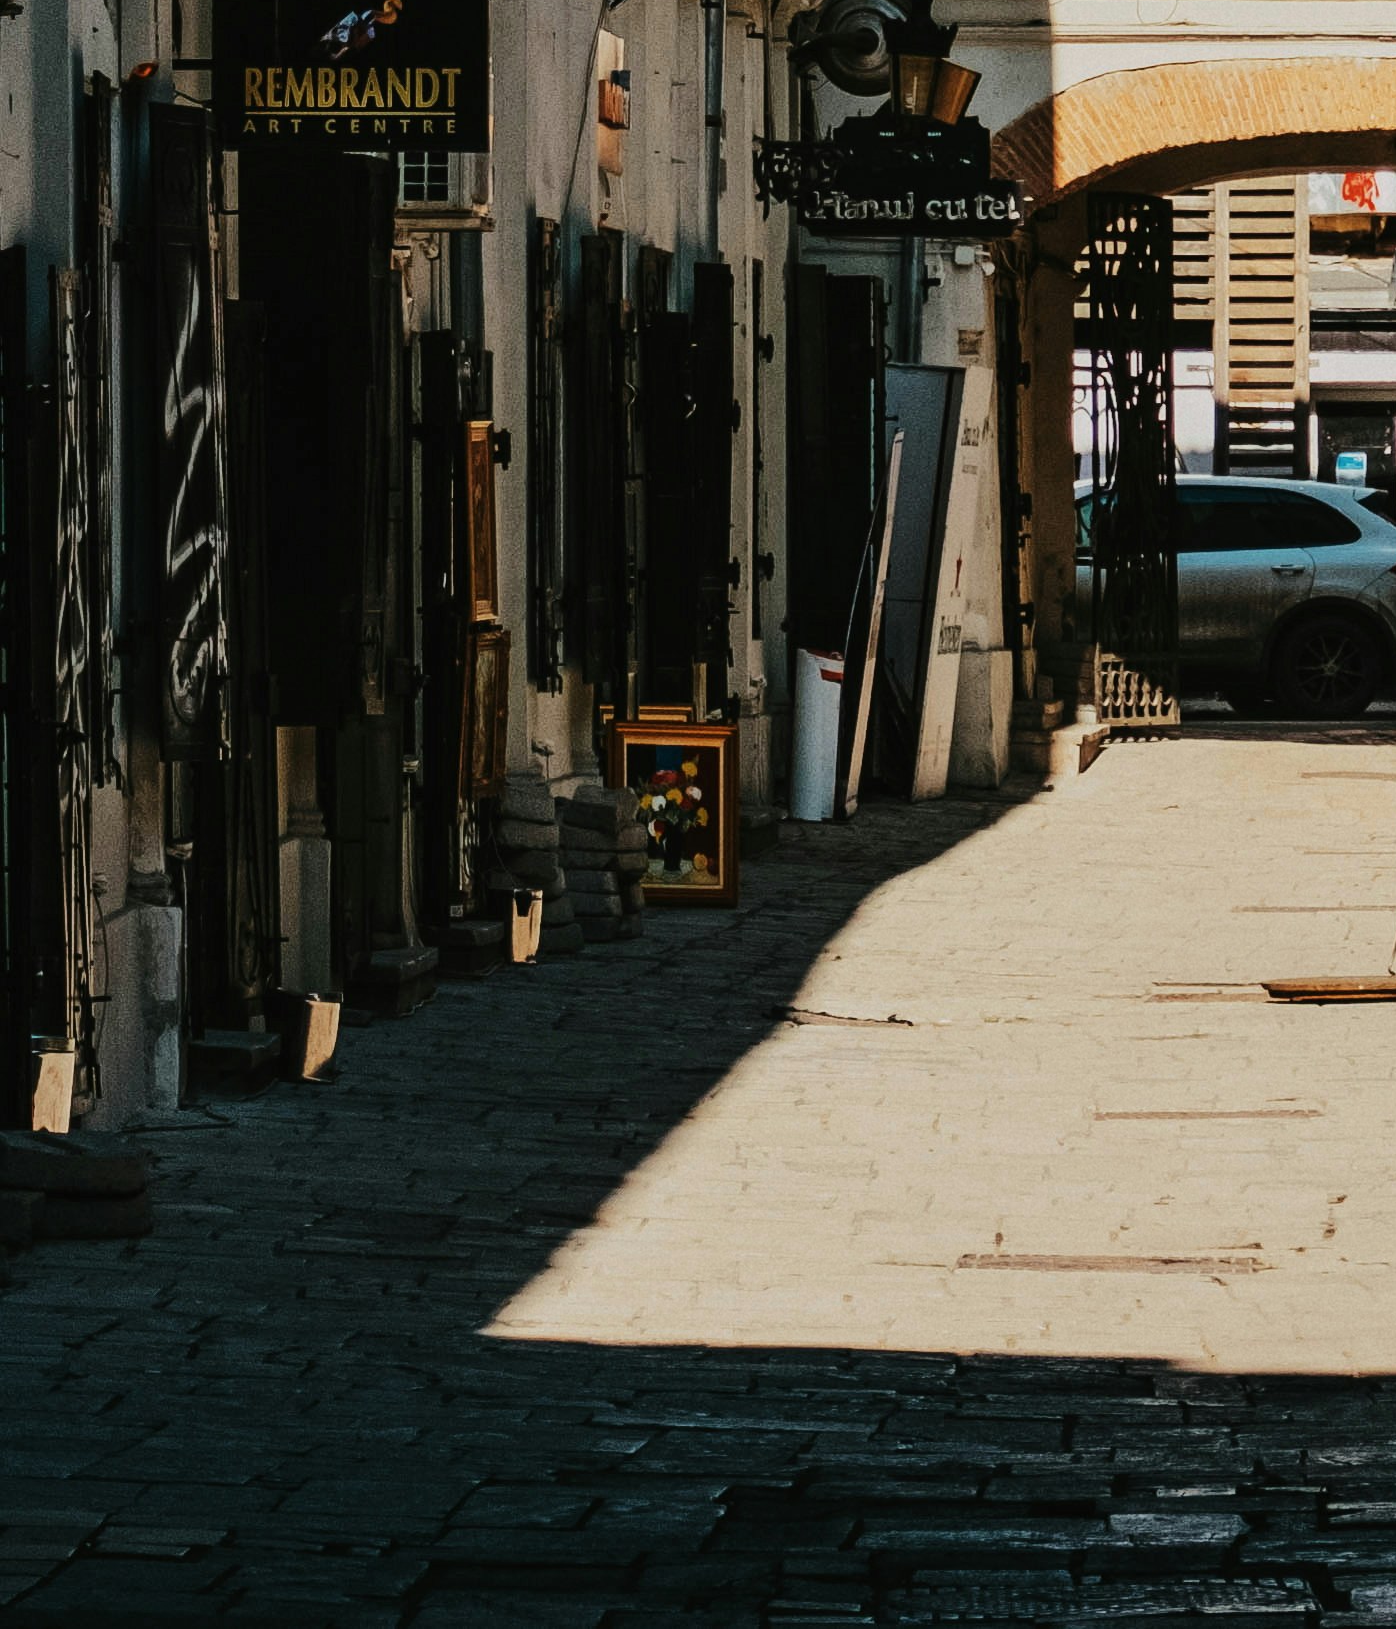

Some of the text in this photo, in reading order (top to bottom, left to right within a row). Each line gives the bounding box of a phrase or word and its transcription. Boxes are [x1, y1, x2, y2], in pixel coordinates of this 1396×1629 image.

[244, 67, 462, 109] REMBRANDT
[243, 118, 457, 135] ART CENTRE
